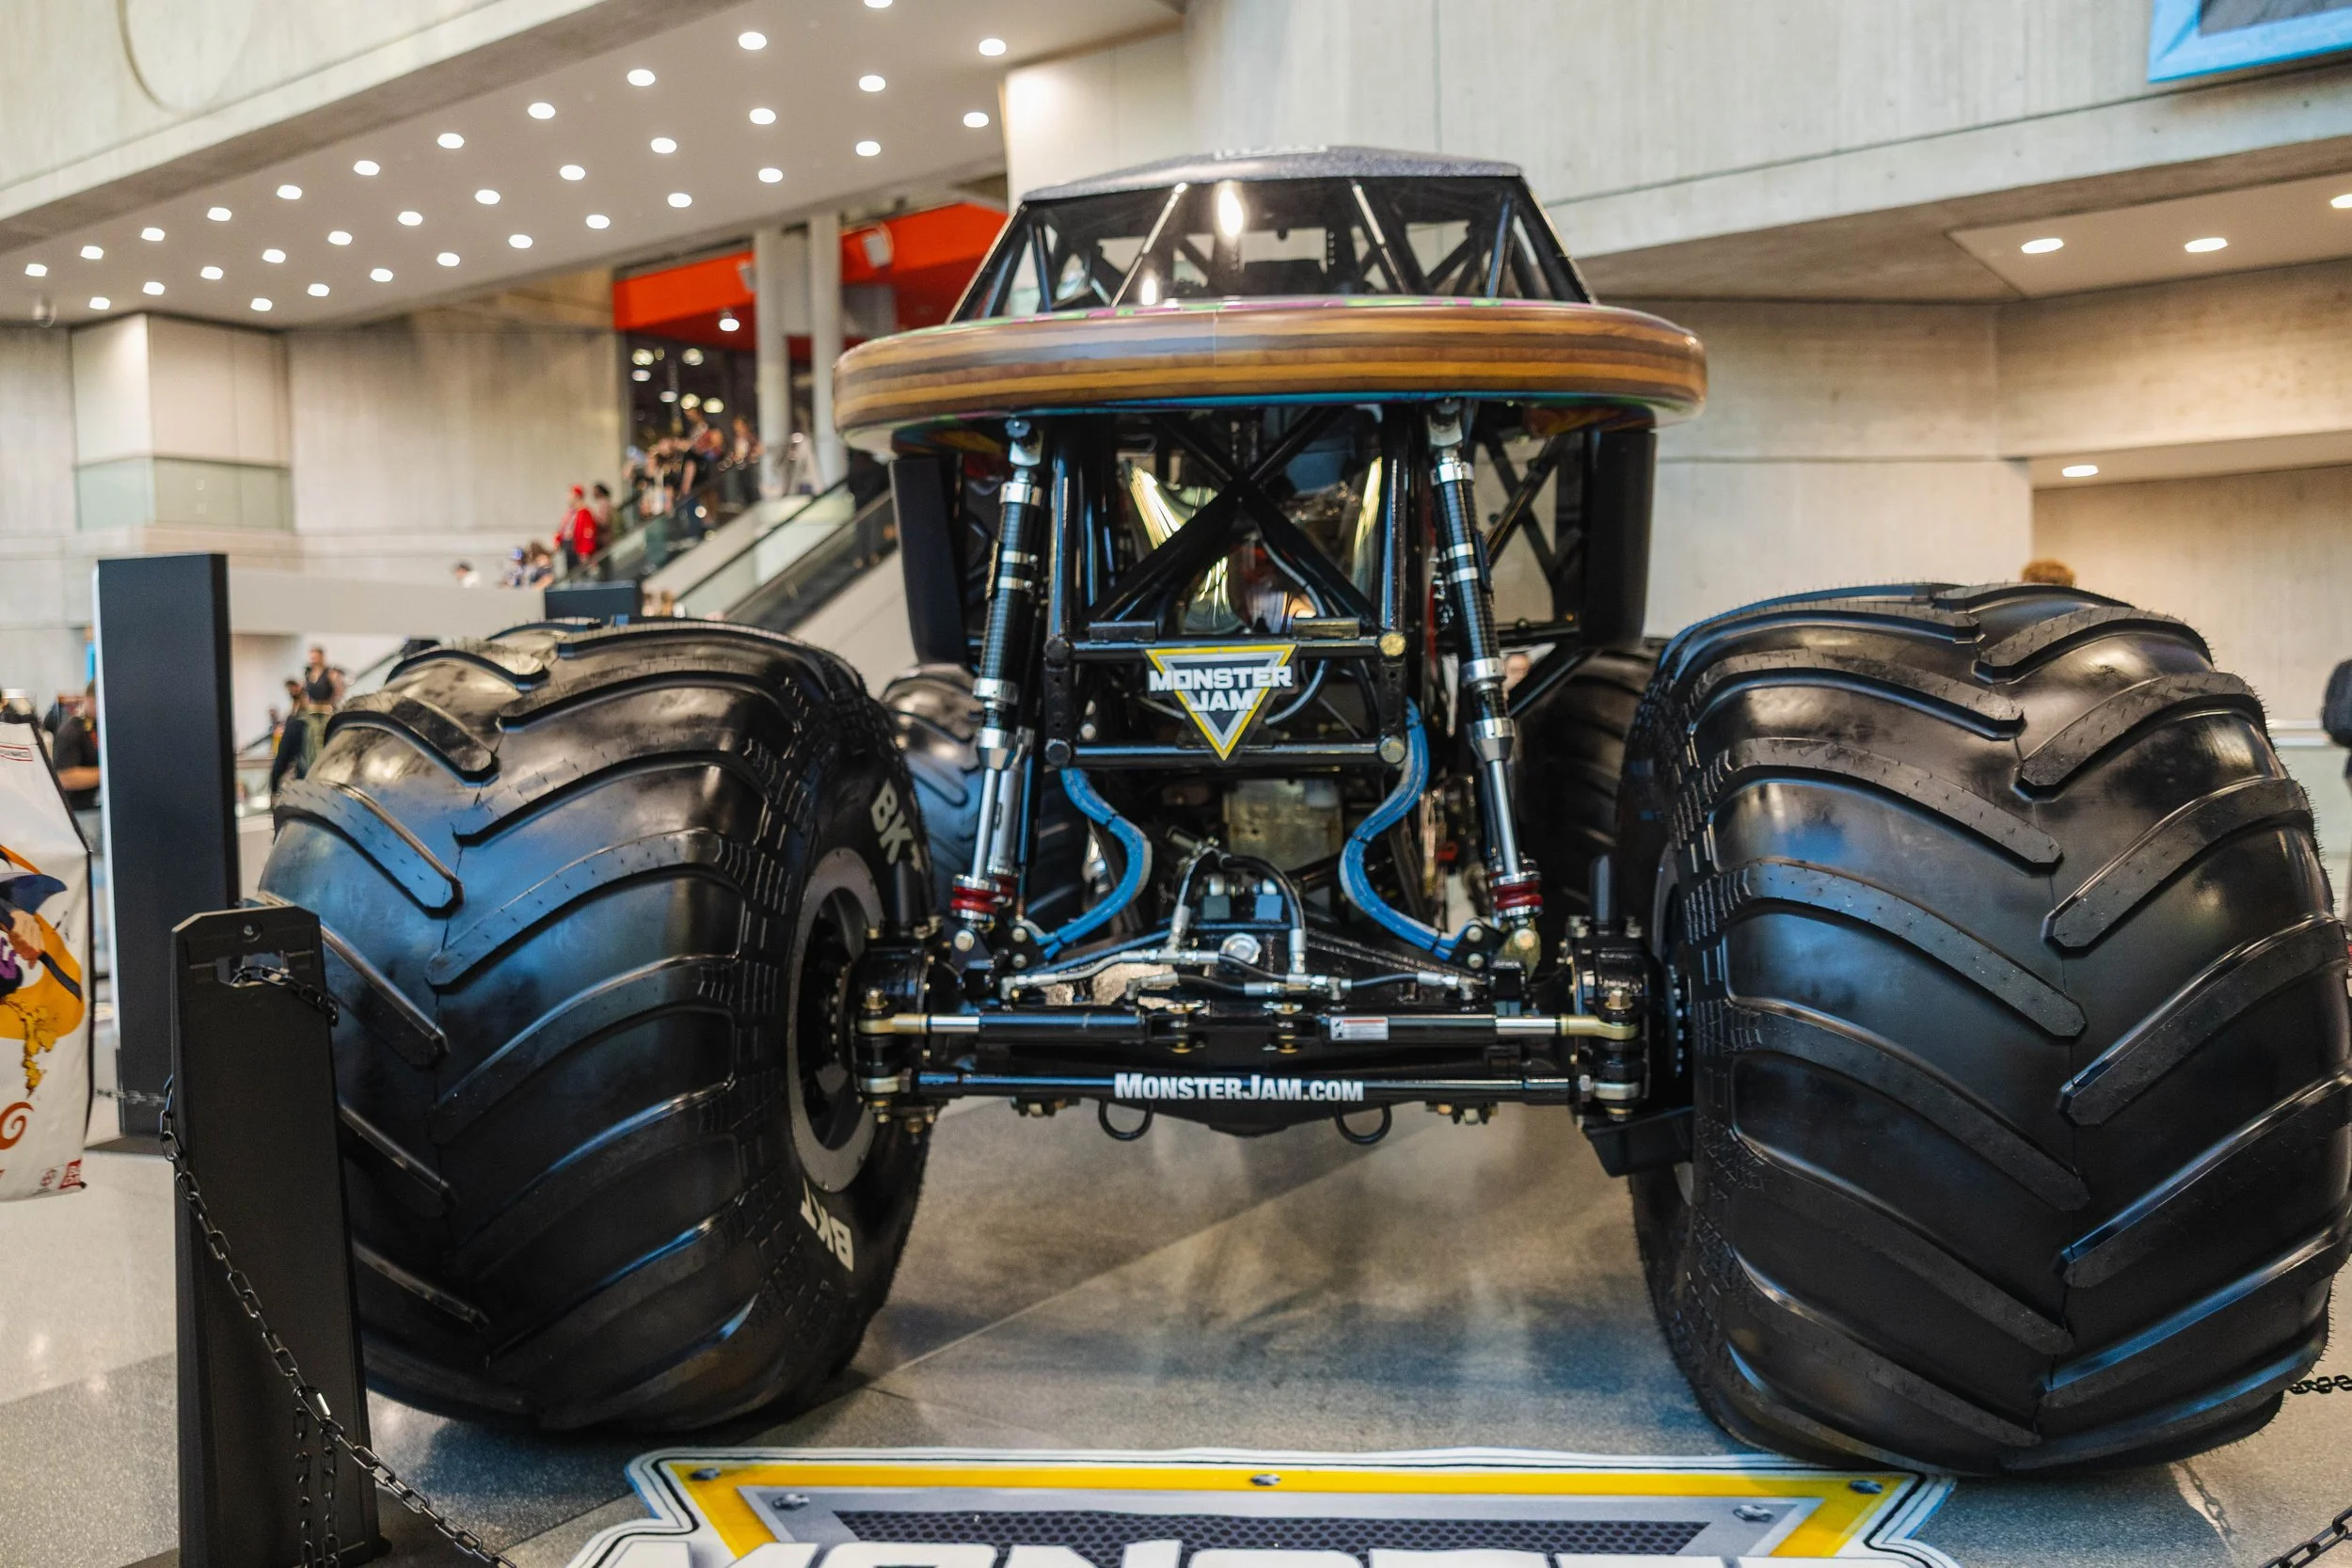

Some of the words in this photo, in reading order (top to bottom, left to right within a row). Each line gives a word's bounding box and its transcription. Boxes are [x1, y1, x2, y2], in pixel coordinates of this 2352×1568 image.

[1149, 666, 1293, 691] MONSTER
[1189, 689, 1254, 712] JAM
[800, 1176, 854, 1272] BKT
